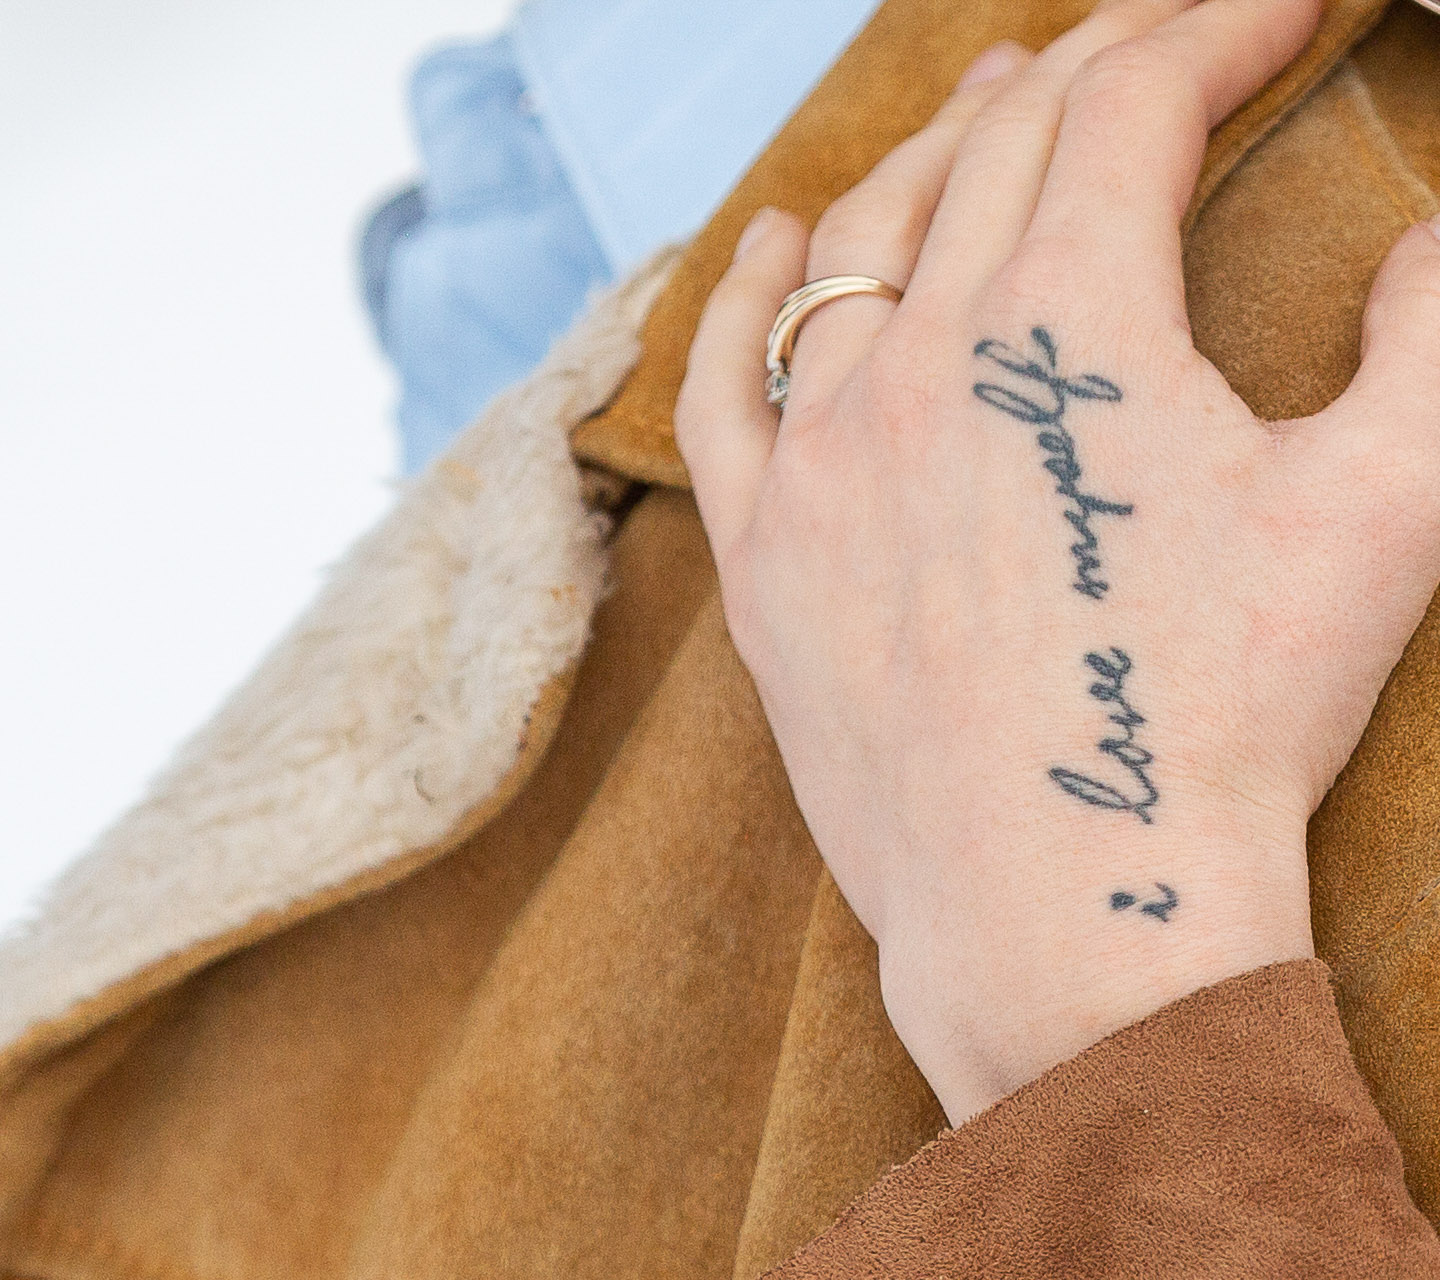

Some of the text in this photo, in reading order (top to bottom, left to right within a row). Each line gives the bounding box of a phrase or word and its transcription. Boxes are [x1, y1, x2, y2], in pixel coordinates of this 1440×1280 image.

[974, 326, 1178, 923] i love myself
